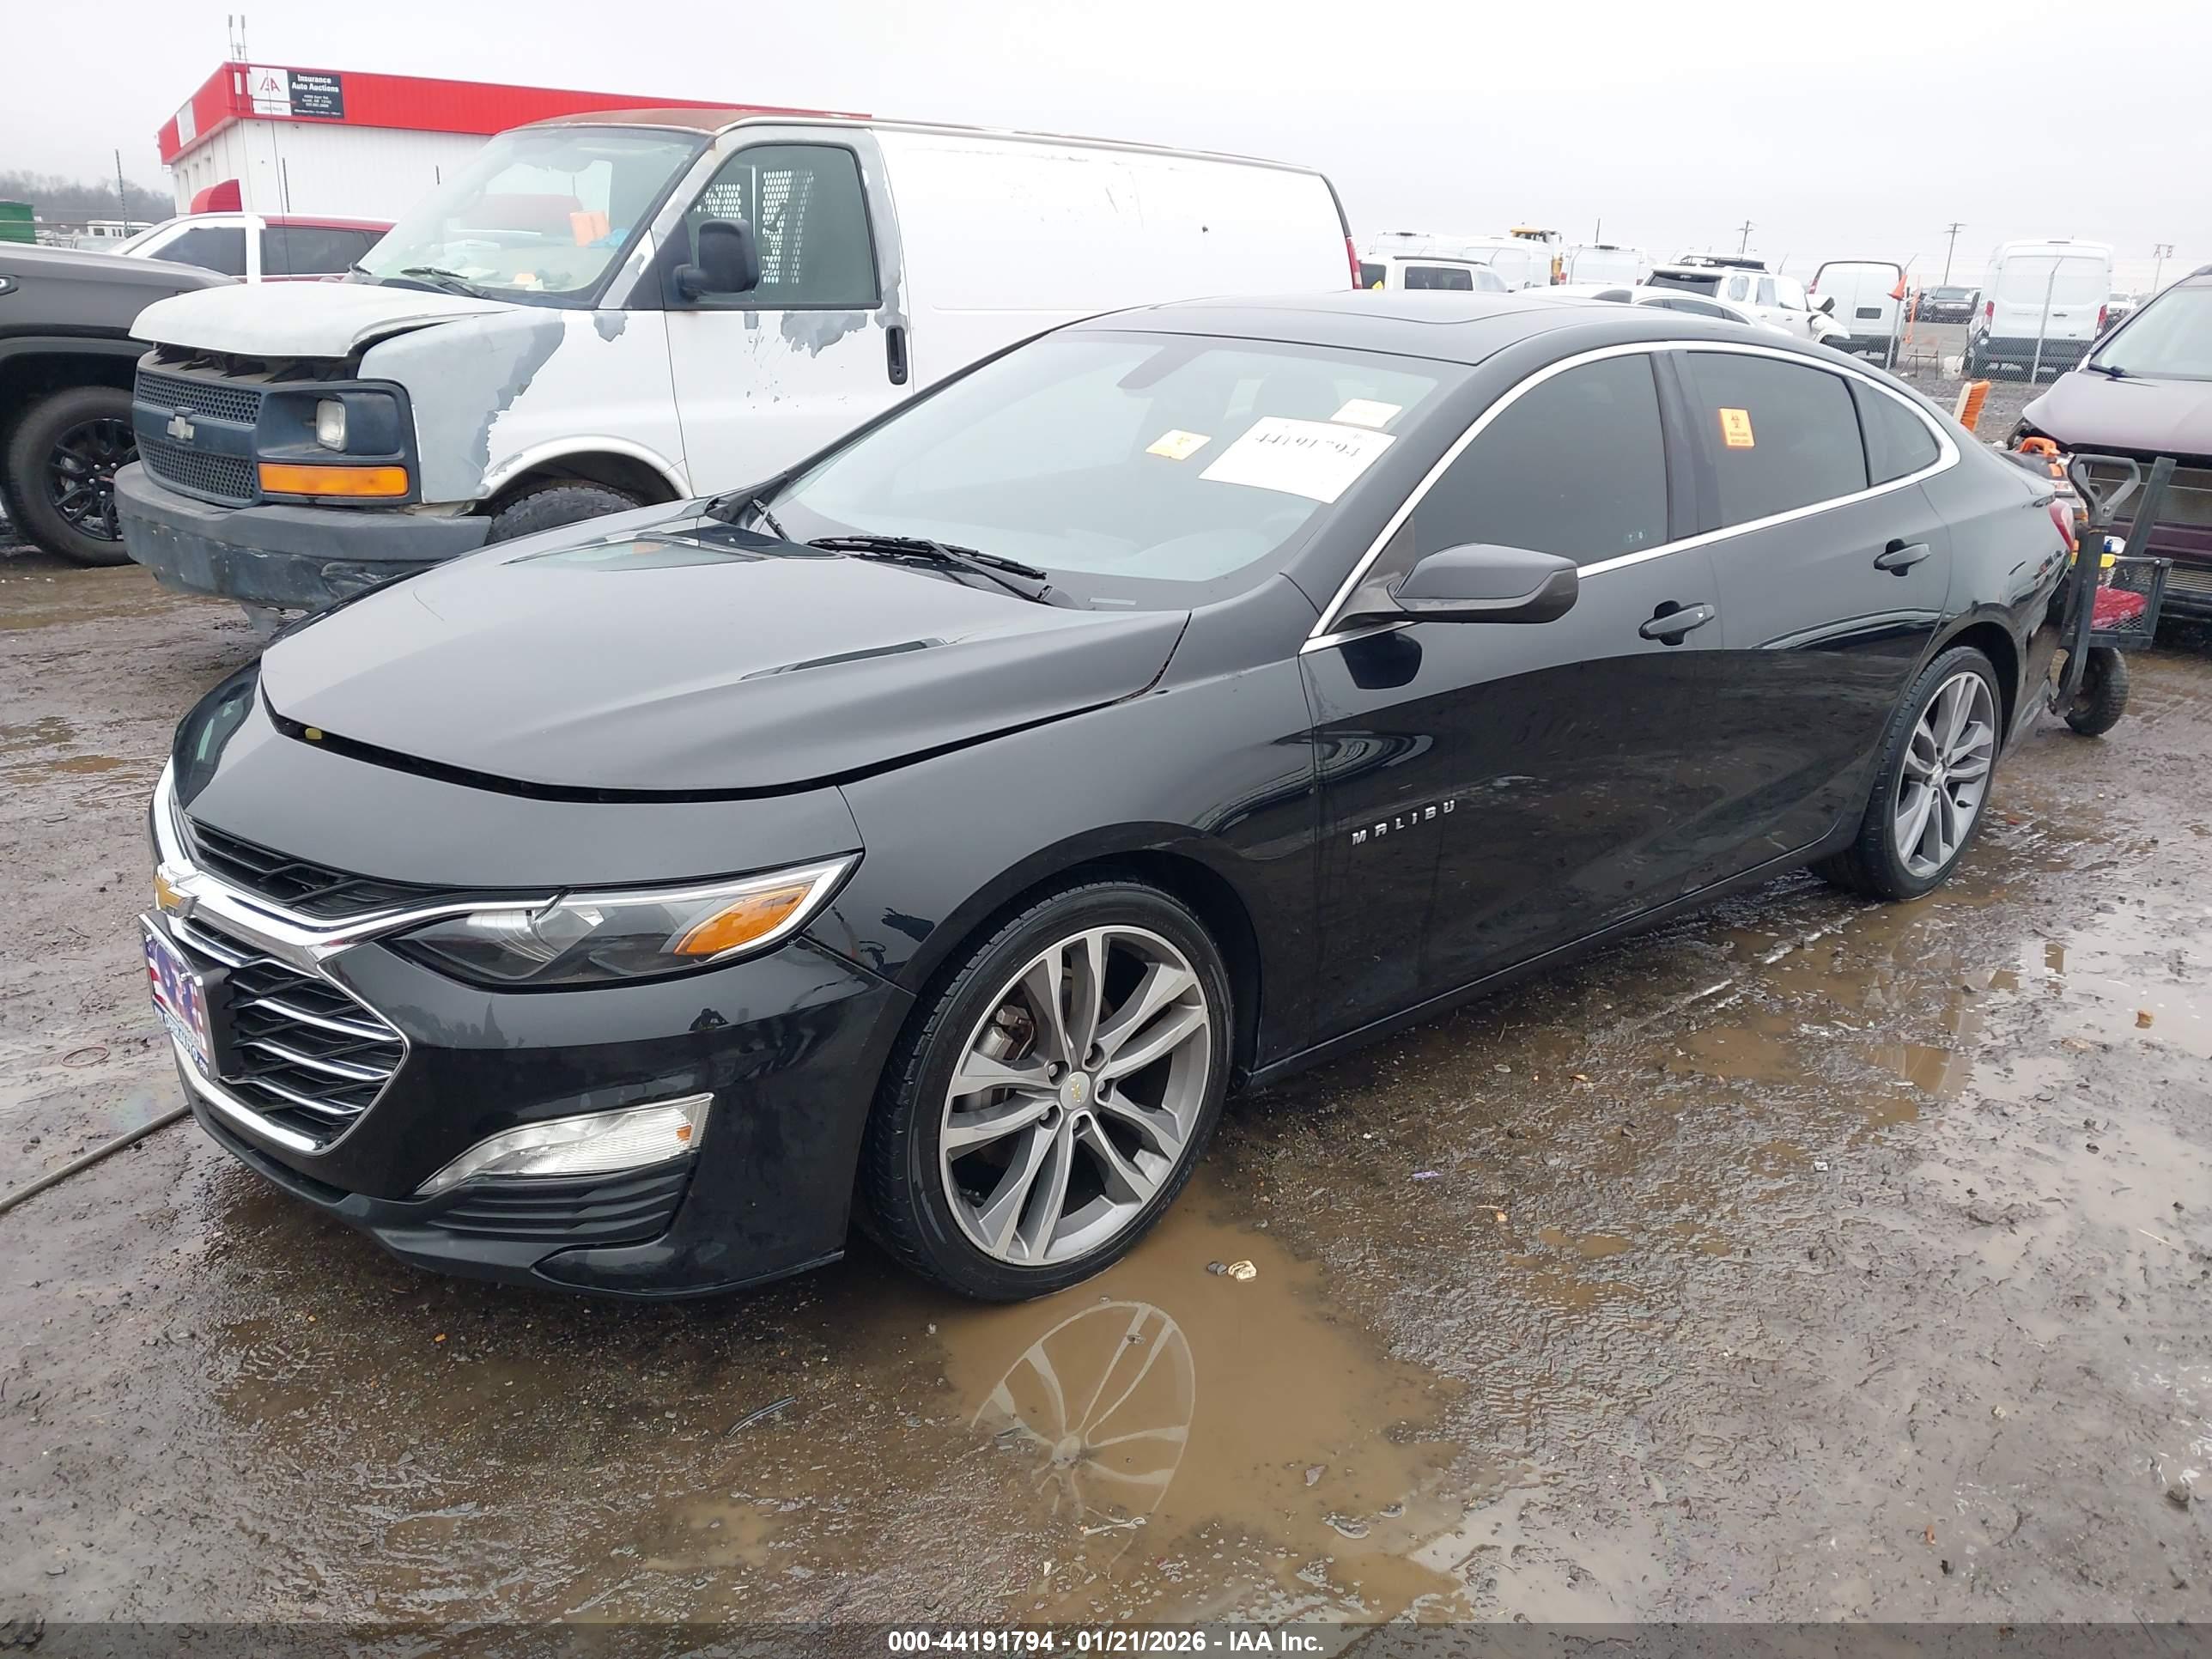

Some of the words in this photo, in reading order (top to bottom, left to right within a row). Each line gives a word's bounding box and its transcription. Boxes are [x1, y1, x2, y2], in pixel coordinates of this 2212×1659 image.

[297, 74, 331, 83] Insurance
[292, 82, 308, 90] Auto
[308, 83, 339, 93] Auctions
[1352, 799, 1455, 845] MALIBU
